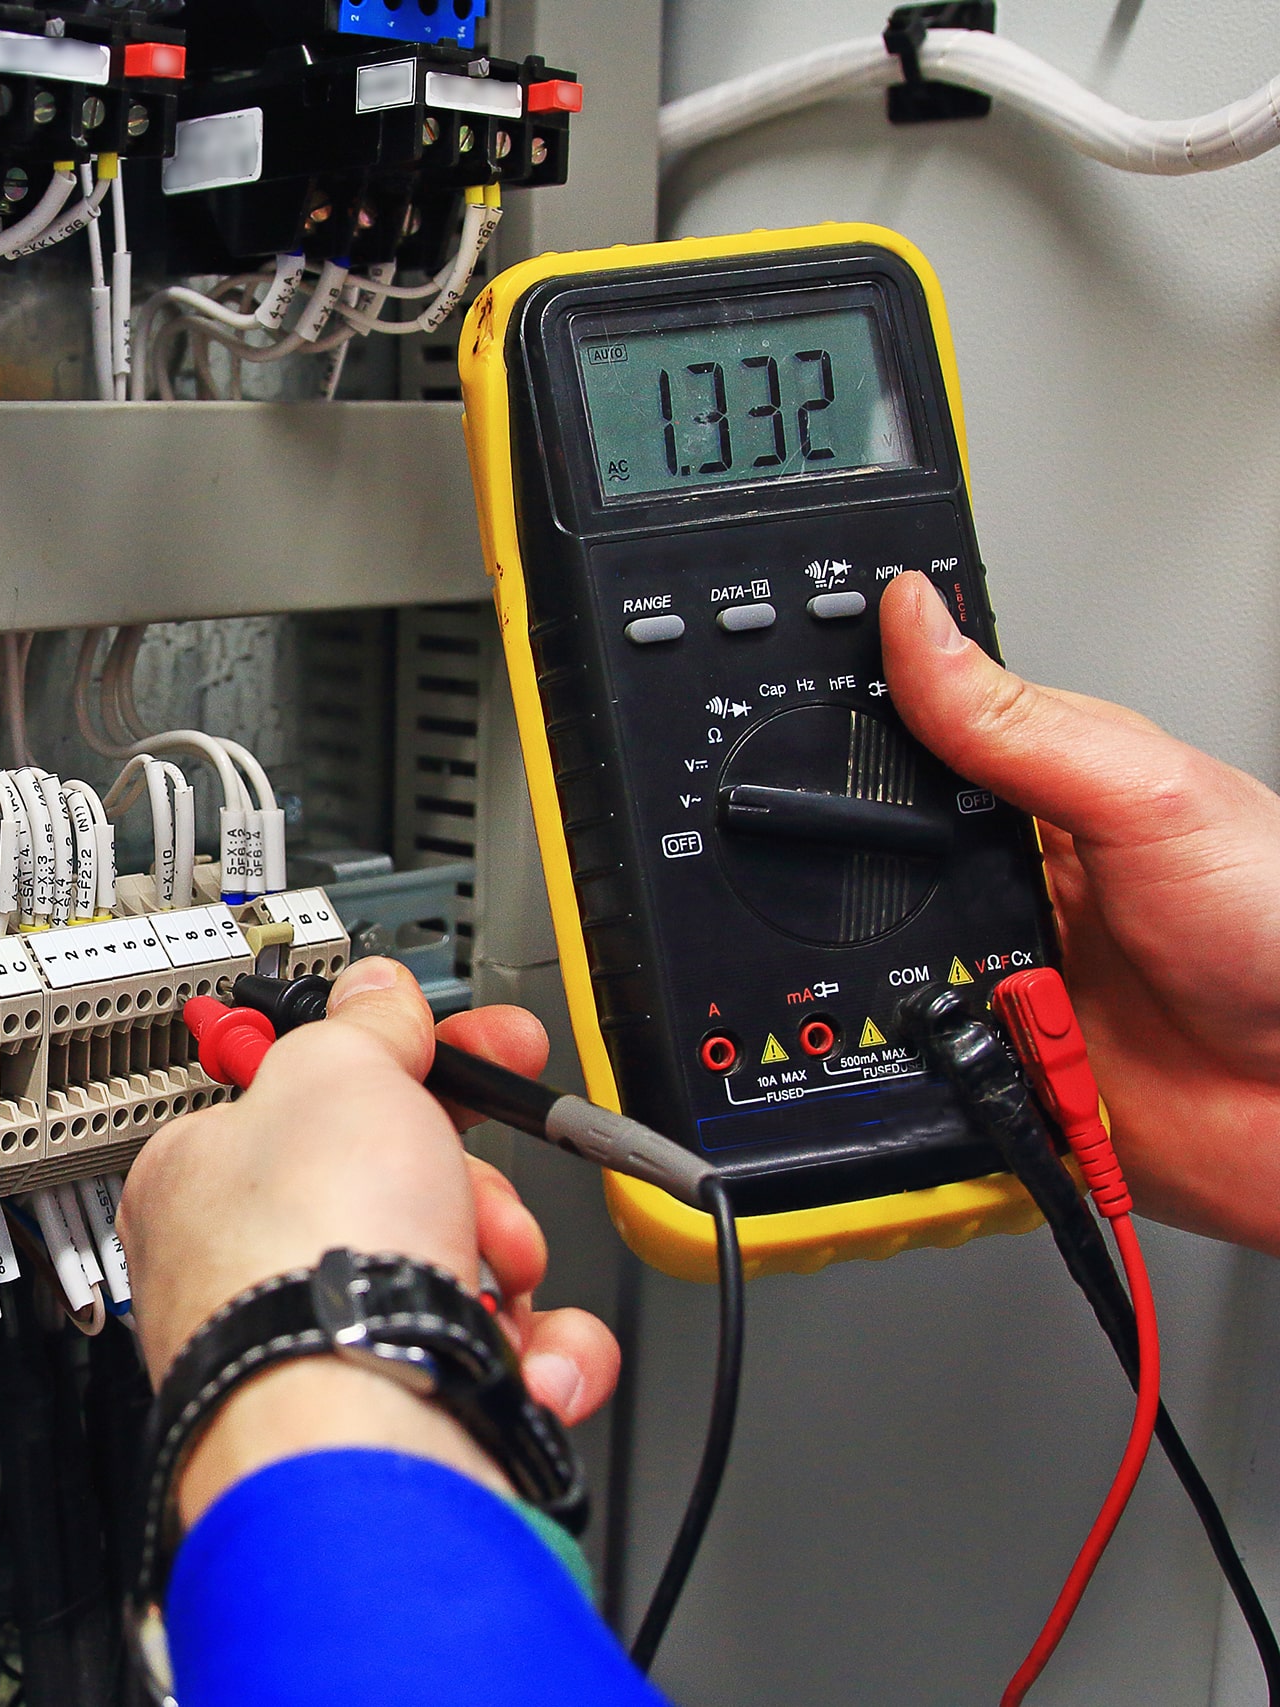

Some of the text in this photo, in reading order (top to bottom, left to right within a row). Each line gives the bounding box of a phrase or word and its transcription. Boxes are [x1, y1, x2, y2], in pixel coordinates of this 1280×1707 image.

[593, 348, 623, 361] AUTO
[659, 349, 835, 476] 1.332
[608, 460, 629, 474] AC
[875, 557, 958, 580] NPN PNP
[623, 595, 672, 613] RANGE
[758, 675, 857, 699] Cap Hz hFE
[707, 727, 723, 744] Ω
[962, 793, 989, 808] OFF
[227, 828, 237, 875] 5-X:A
[667, 836, 697, 853] OFF
[76, 805, 92, 909] 4-F2:2 (N1)
[37, 855, 48, 905] 4-X:3
[299, 910, 329, 924] B C
[45, 920, 238, 963] 1 2 3 4 5 6 7 8 9 10
[13, 961, 27, 972] C
[888, 965, 931, 987] COM
[787, 988, 814, 1005] mA
[708, 1003, 721, 1017] A
[840, 1047, 908, 1068] 500mA MAX
[756, 1069, 808, 1088] 10A MAX
[862, 1063, 901, 1080] FUSED
[766, 1087, 805, 1103] FUSED
